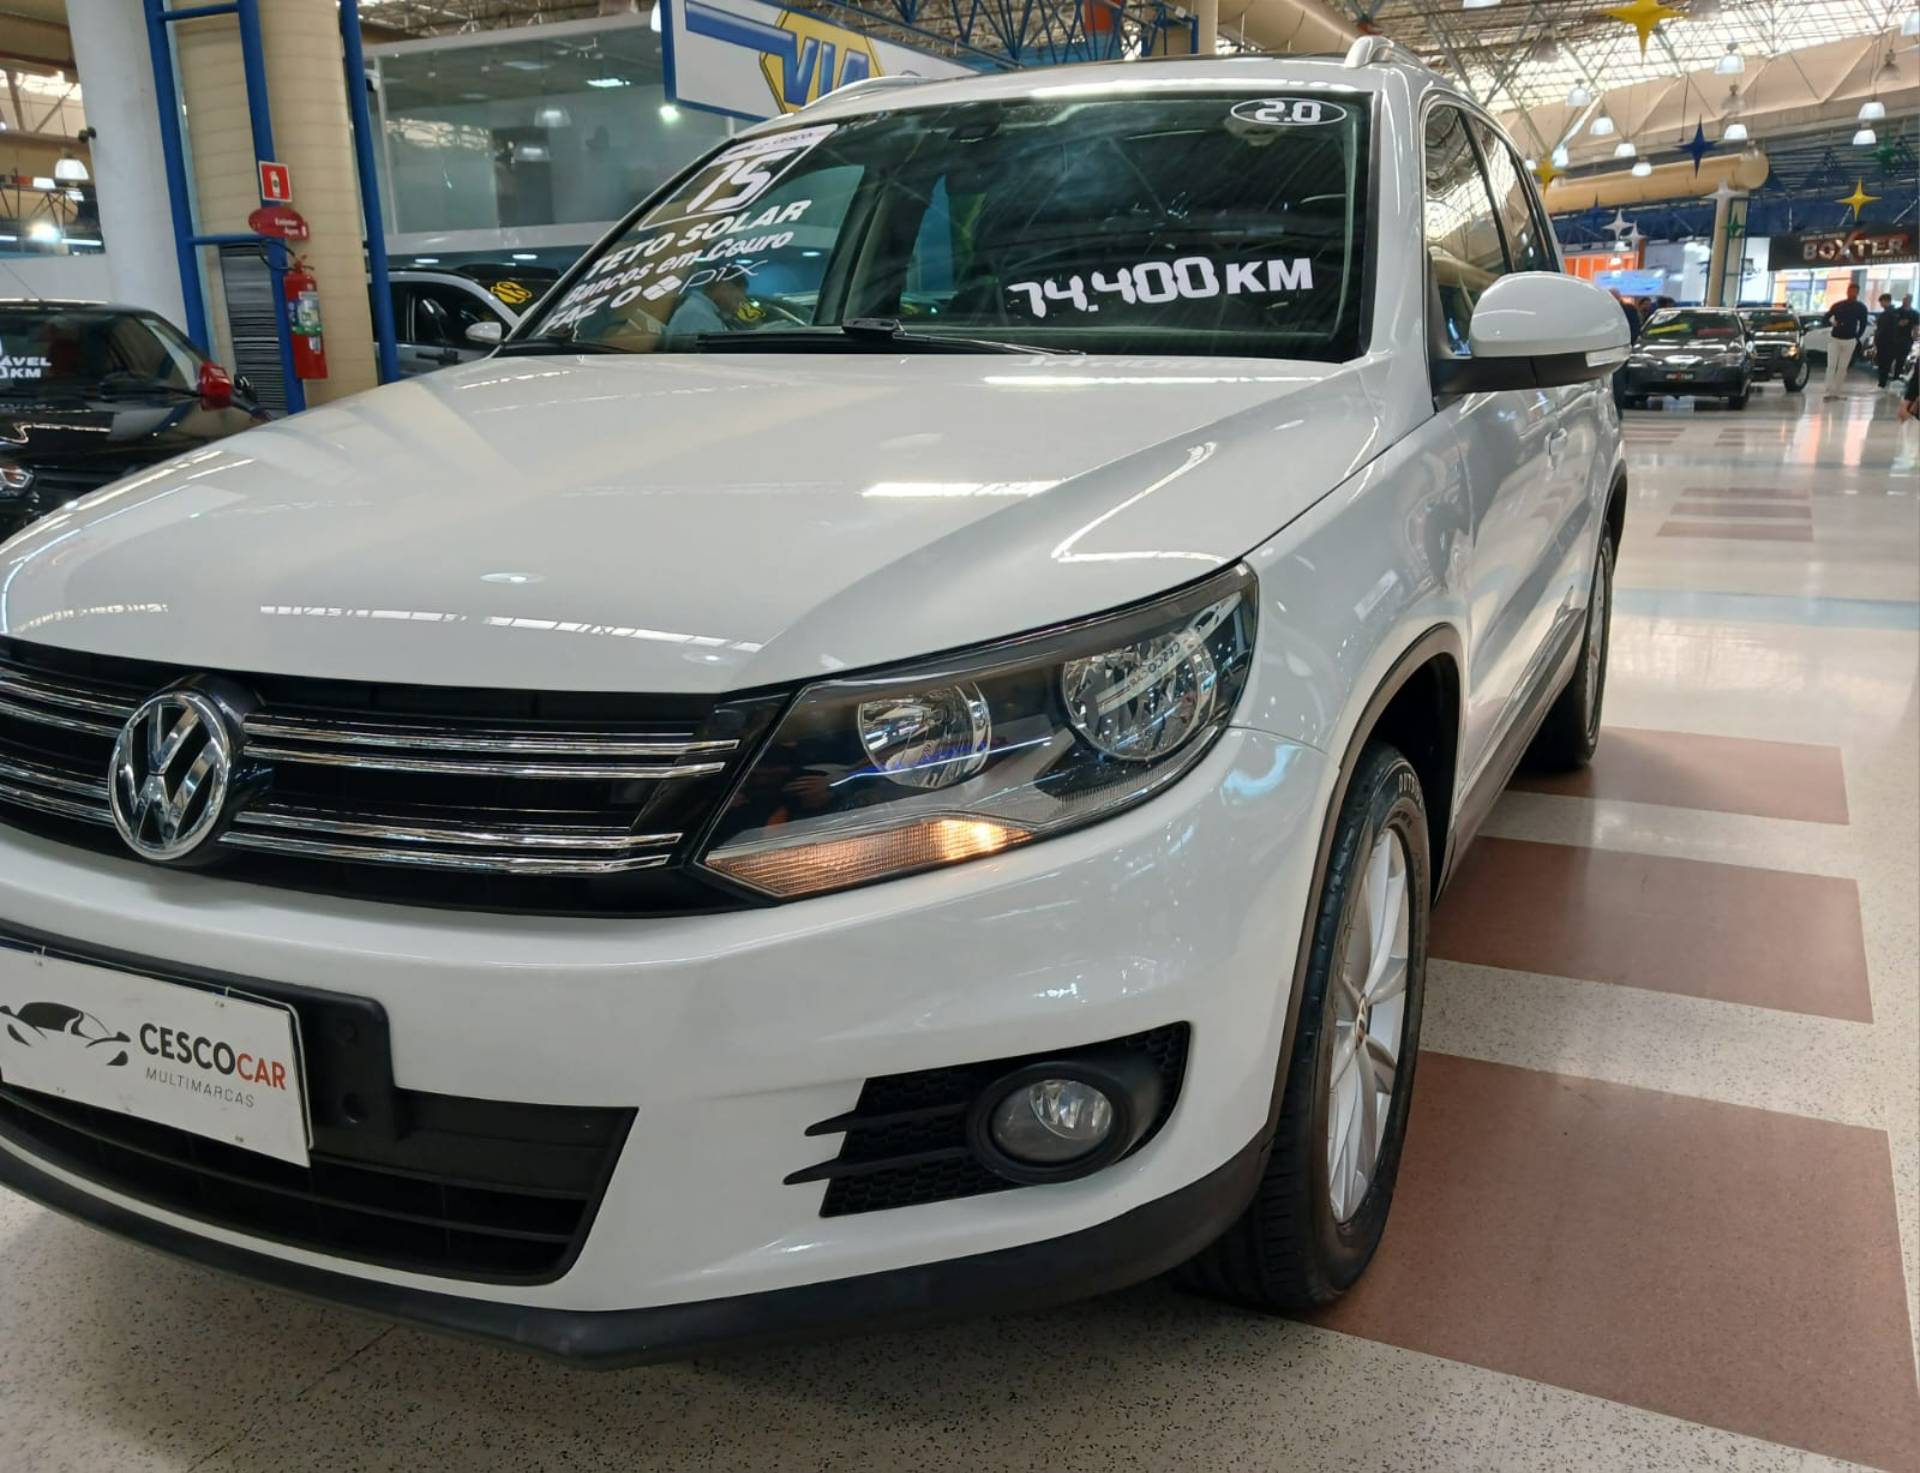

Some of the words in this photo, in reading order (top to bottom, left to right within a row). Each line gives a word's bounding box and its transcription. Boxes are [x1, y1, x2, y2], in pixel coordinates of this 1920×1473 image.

[1255, 100, 1321, 122] 2.0
[685, 149, 797, 213] 15
[558, 263, 654, 309] Bancos
[656, 249, 703, 274] em
[705, 231, 794, 262] Couro
[585, 232, 676, 280] TETO
[677, 200, 812, 247] SOLAR
[1803, 237, 1903, 261] BOXTER
[536, 294, 611, 337] FAZ
[610, 285, 643, 308] O
[678, 259, 768, 295] pix
[1007, 256, 1219, 319] 74.400
[1226, 257, 1314, 295] KM
[139, 1022, 287, 1091] CESCOCAR
[145, 1067, 255, 1109] MULTIMARCAS
